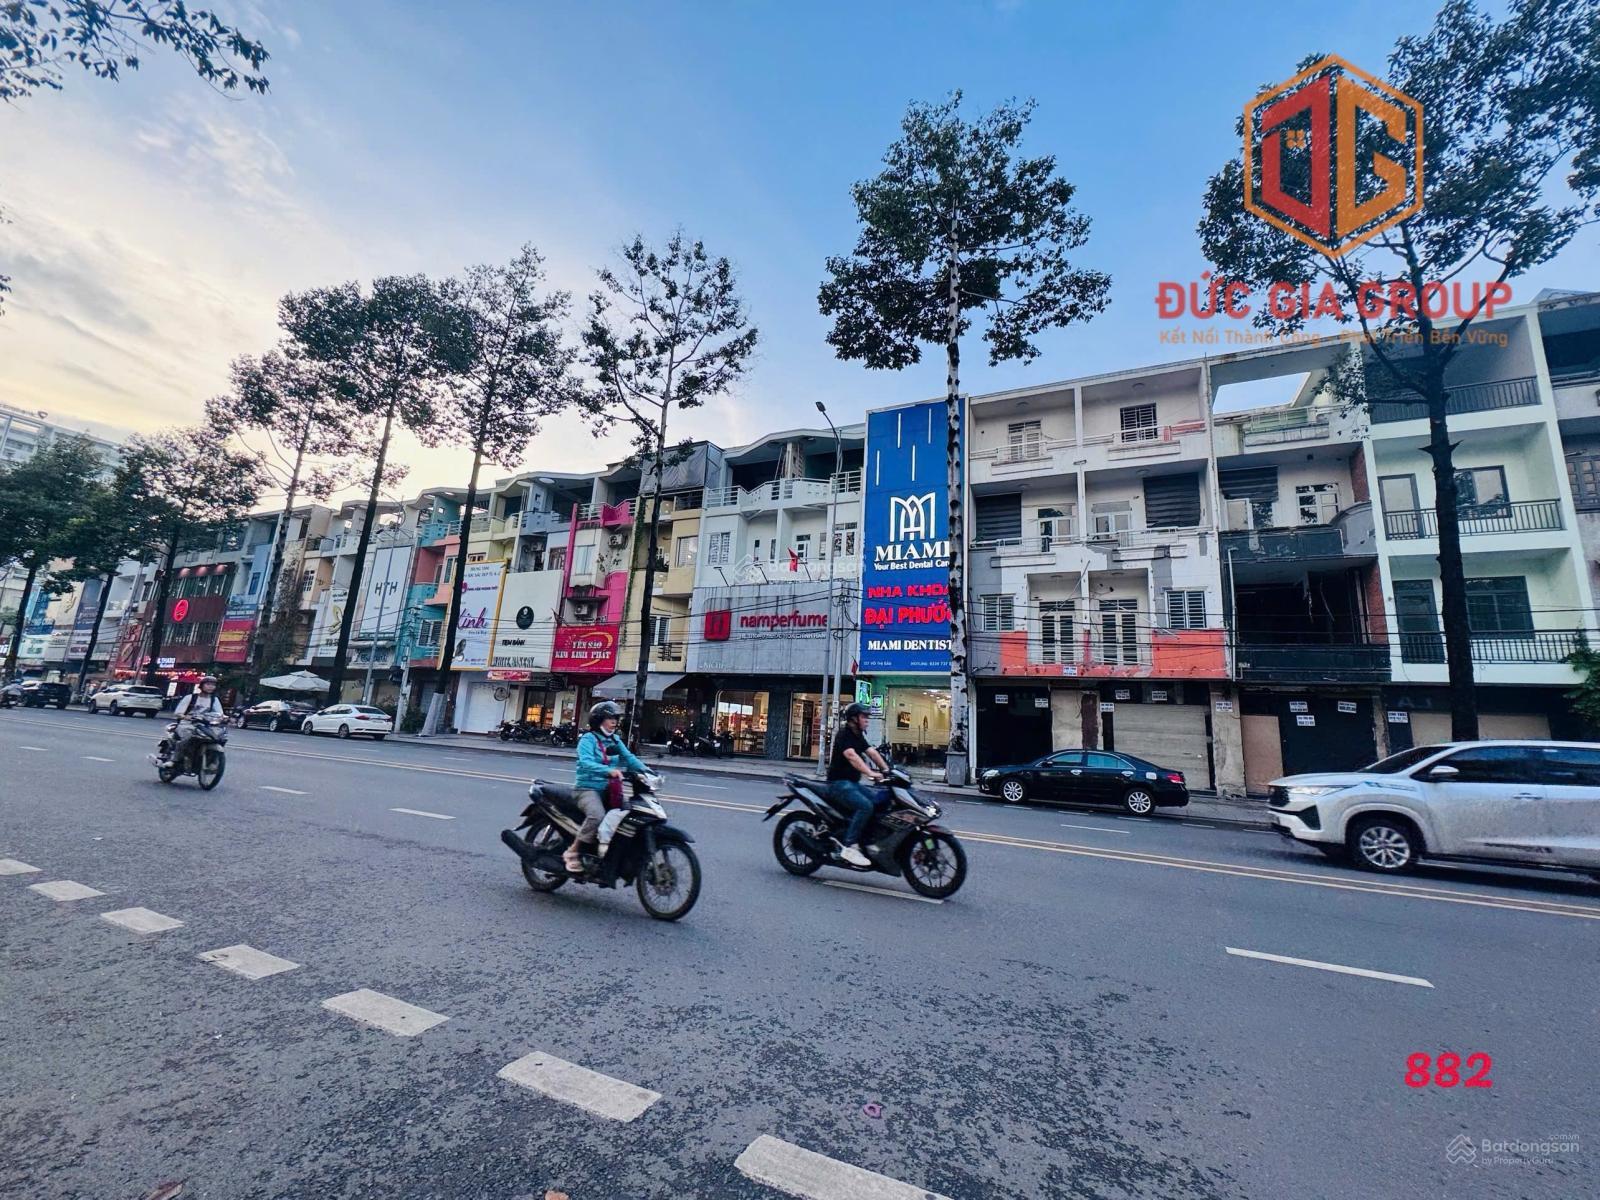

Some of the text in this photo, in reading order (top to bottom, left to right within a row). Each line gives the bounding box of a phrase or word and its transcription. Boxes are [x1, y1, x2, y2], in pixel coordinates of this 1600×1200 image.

[874, 541, 950, 562] MIAMI
[874, 562, 890, 571] Your
[890, 562, 908, 570] Best
[909, 560, 934, 569] Dental
[867, 584, 903, 599] NHA
[740, 610, 828, 631] namperfume
[864, 606, 894, 629] ĐẠI
[867, 640, 902, 651] MIAMI
